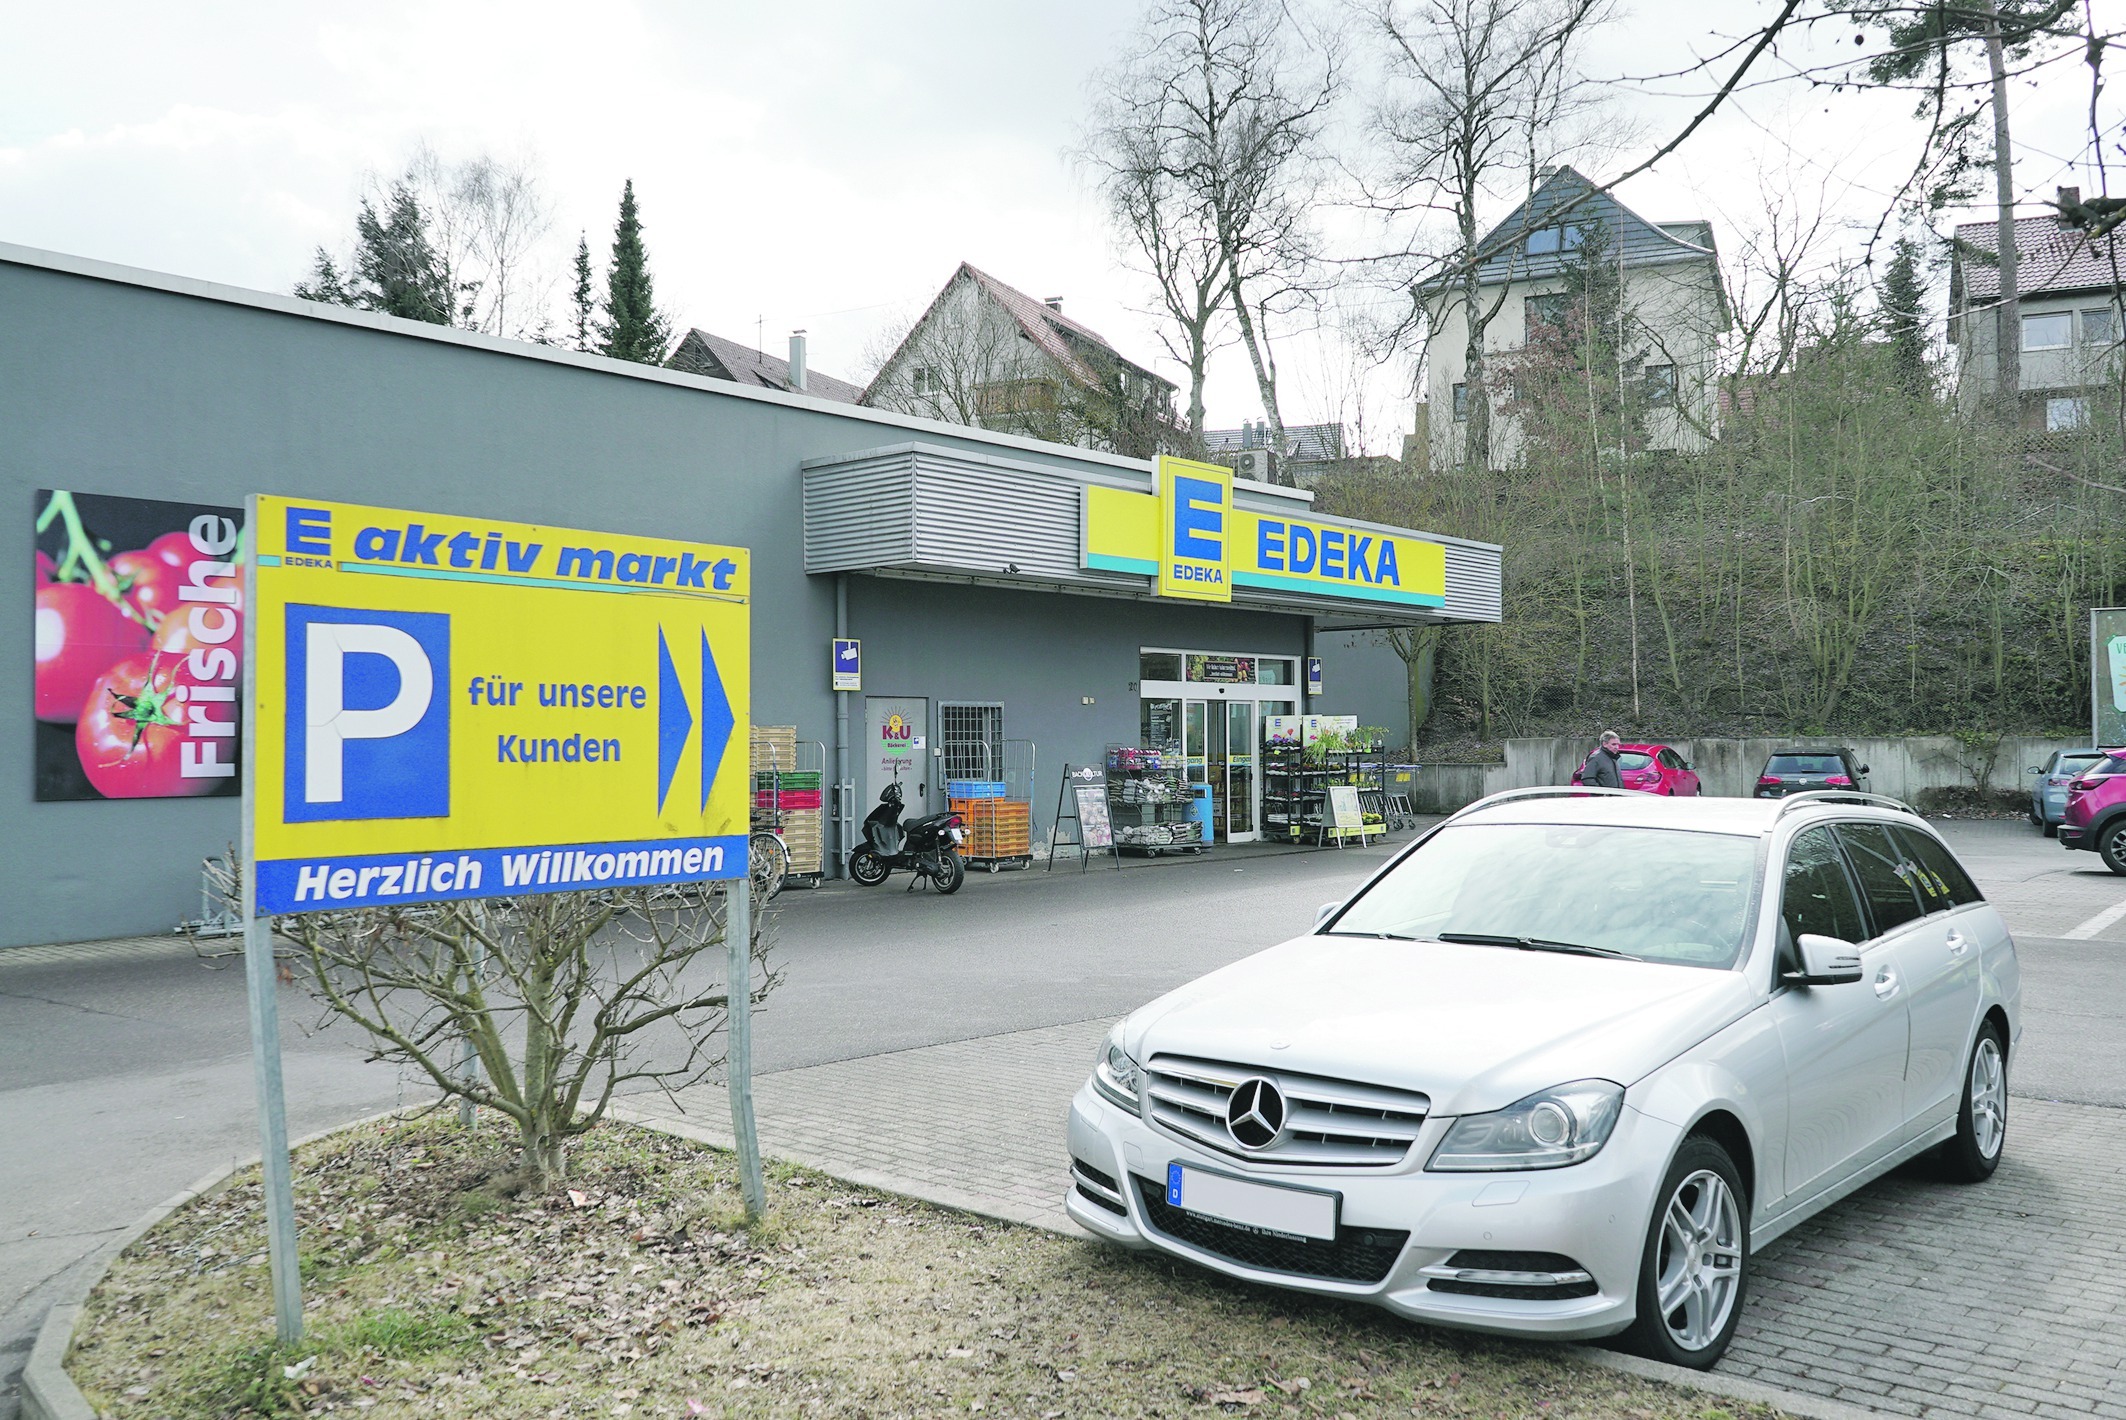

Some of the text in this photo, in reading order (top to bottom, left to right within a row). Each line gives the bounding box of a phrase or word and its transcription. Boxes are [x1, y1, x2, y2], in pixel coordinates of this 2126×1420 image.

[1174, 475, 1222, 562] E
[285, 506, 737, 591] E aktiv markt
[285, 556, 333, 569] EDEKA
[1258, 519, 1400, 586] EDEKA
[1173, 564, 1223, 584] EDEKA
[178, 514, 237, 778] Frische
[468, 676, 647, 709] für unsere
[1128, 682, 1138, 691] 20
[305, 622, 433, 803] P
[498, 733, 621, 763] Kunden
[882, 725, 911, 740] K&U
[881, 757, 912, 767] Anlierung
[295, 846, 724, 901] Herzlich Willkommen
[1172, 1188, 1179, 1199] D
